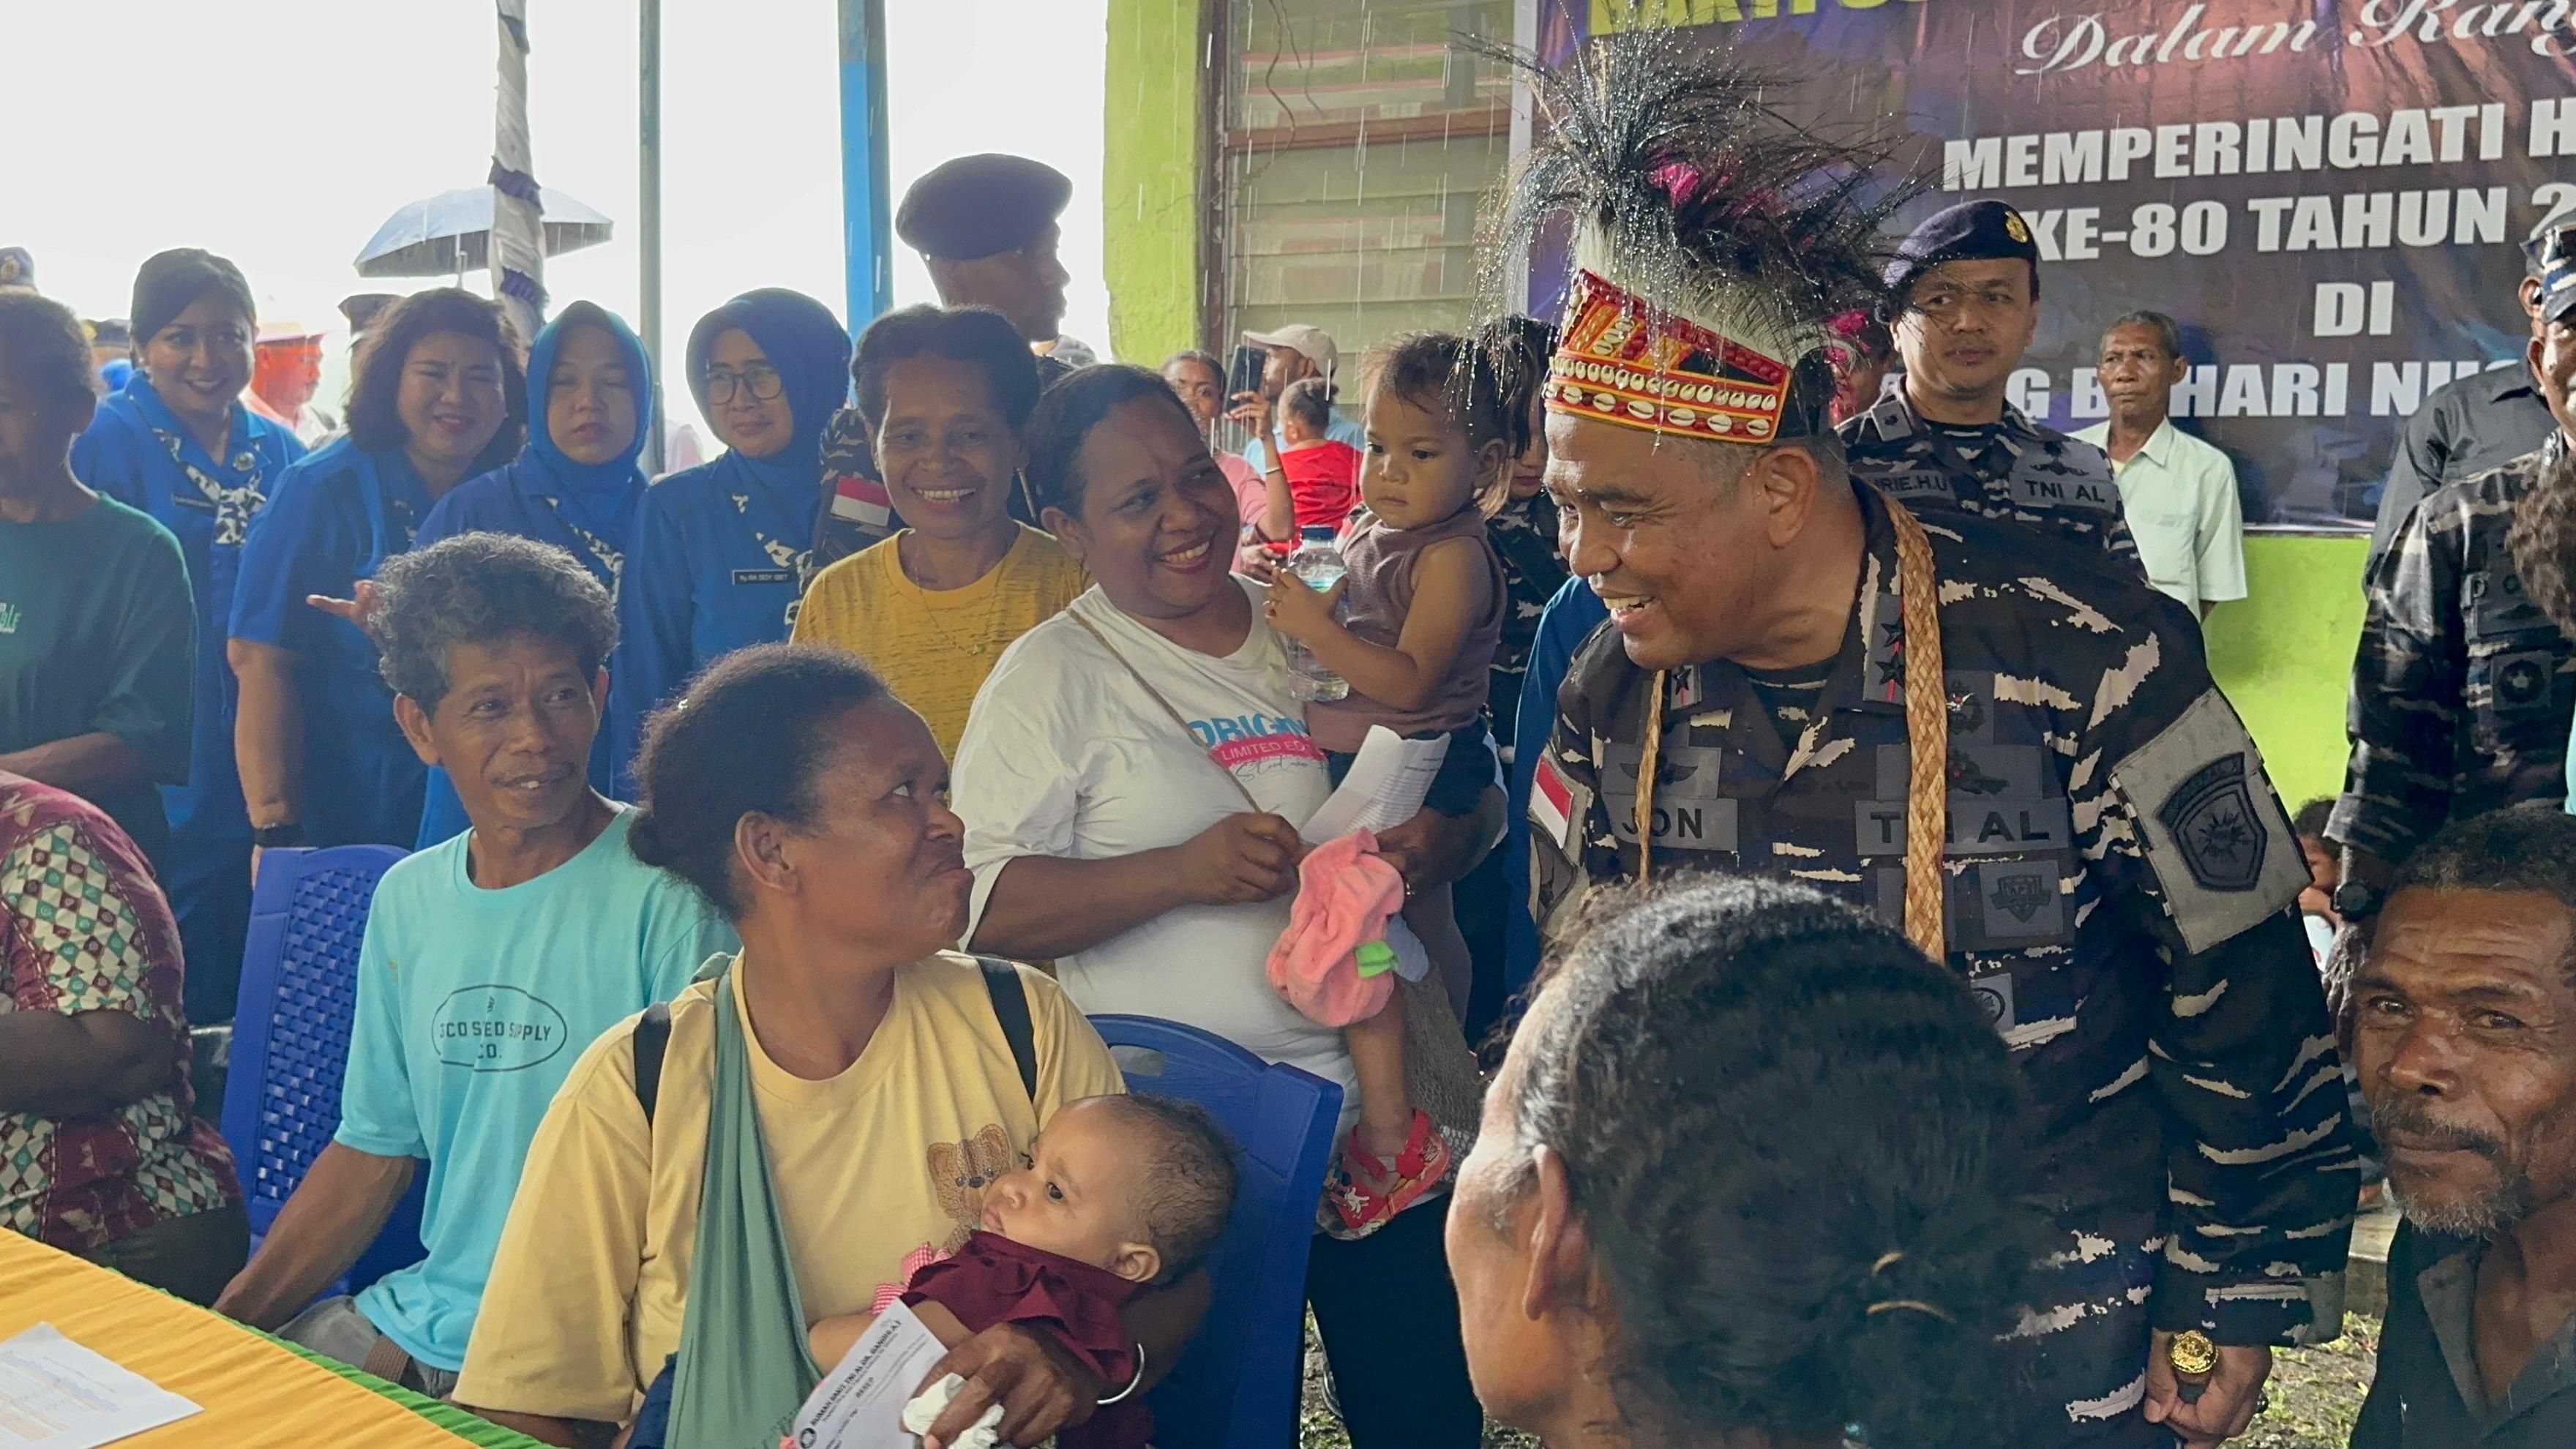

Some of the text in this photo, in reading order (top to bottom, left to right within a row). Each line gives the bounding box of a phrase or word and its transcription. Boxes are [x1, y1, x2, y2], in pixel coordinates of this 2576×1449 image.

[2015, 0, 2576, 74] Dalam Ran
[1942, 102, 2506, 192] MEMPERINGATI
[2021, 200, 2228, 261] KE-80
[2247, 187, 2508, 252] TAHUN
[2314, 281, 2394, 337] DI
[2070, 363, 2348, 418] BHARI
[2024, 479, 2106, 503] TNI AL
[1221, 741, 1281, 761] LIMITED
[1870, 811, 2051, 844] TI AL
